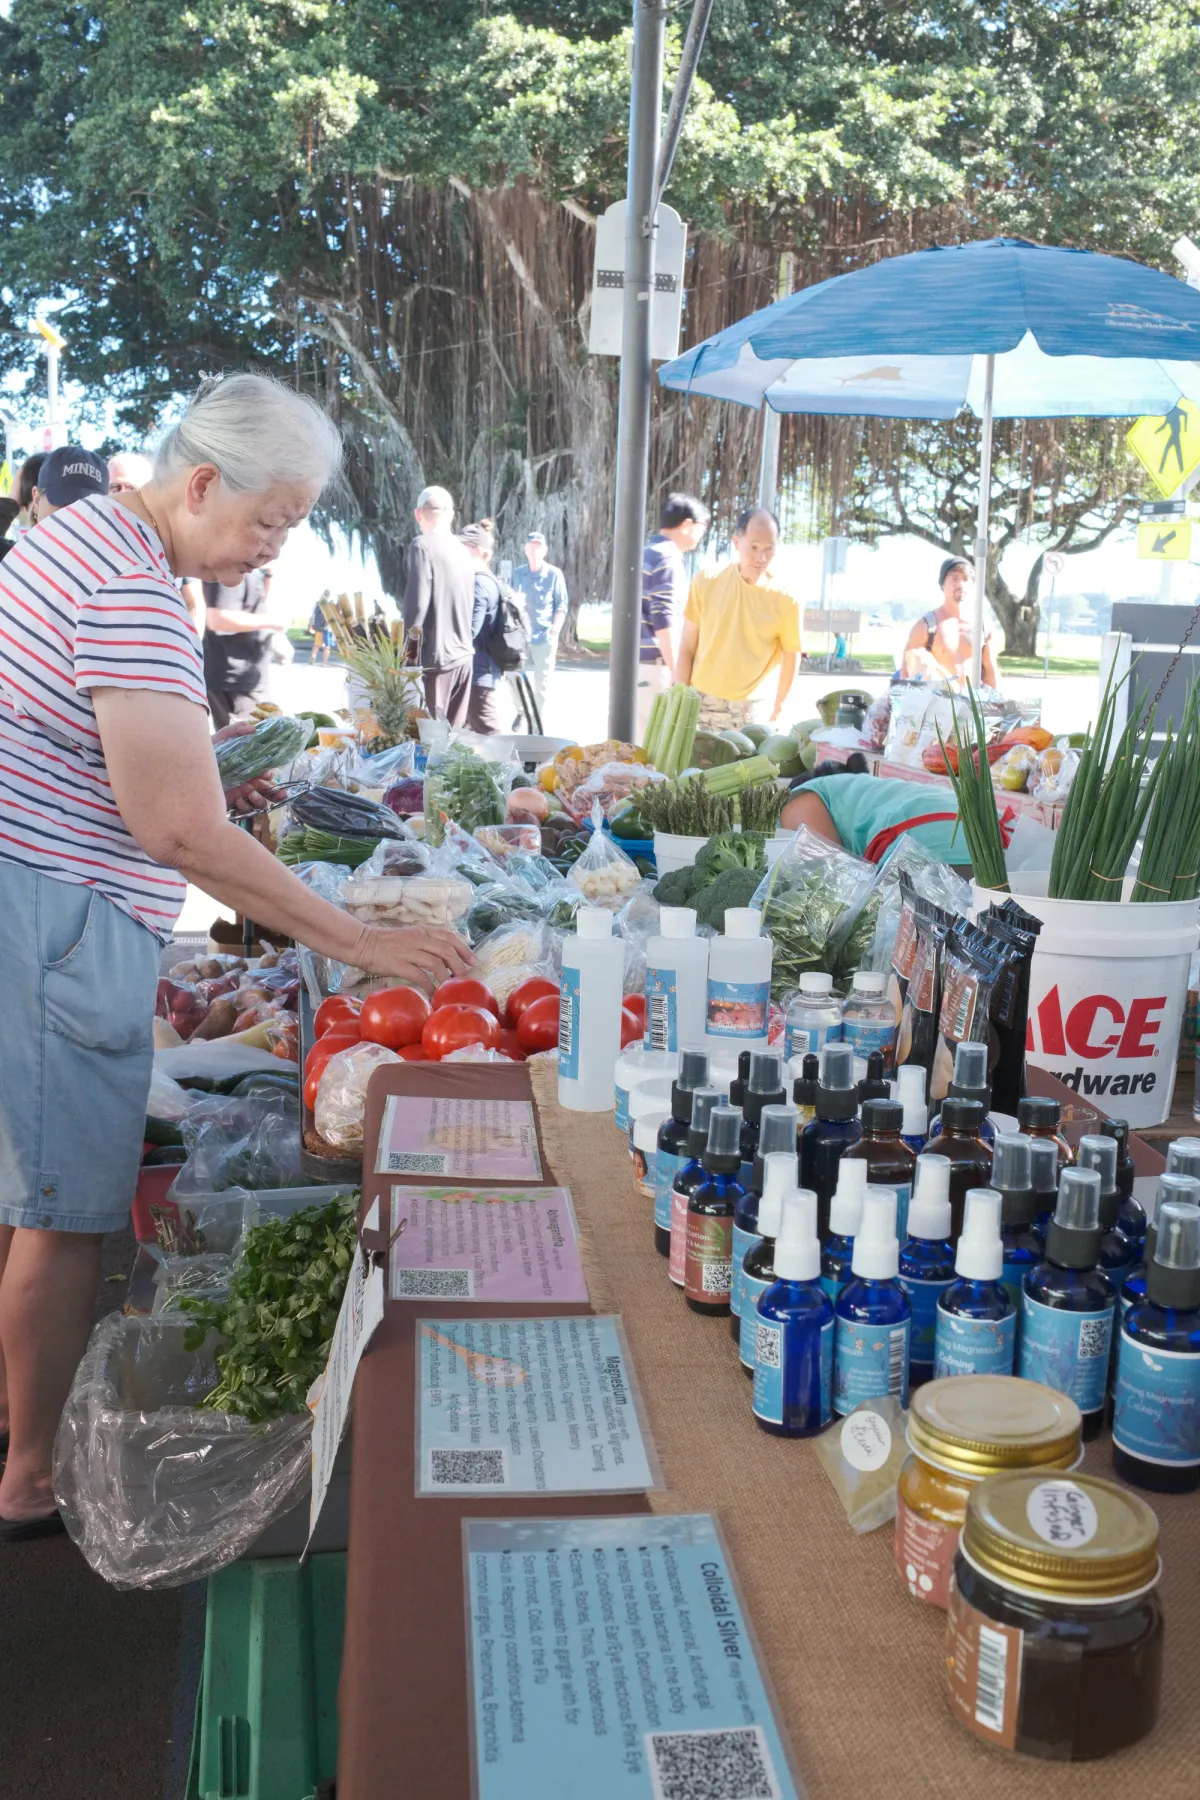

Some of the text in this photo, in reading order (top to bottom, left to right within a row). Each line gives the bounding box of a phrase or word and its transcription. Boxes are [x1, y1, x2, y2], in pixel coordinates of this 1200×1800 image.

[61, 462, 103, 484] MINES
[1026, 984, 1168, 1060] ACE
[1049, 1067, 1157, 1096] rdware
[539, 1367, 553, 1389] Flashes
[601, 1355, 630, 1405] Magnesium
[505, 1393, 519, 1419] Pressure
[540, 1390, 557, 1422] symptoms
[554, 1347, 567, 1362] Brain
[565, 1423, 582, 1450] Memory
[470, 1426, 482, 1444] Make
[505, 1420, 523, 1455] Regulation
[528, 1426, 542, 1449] Lowers
[531, 1450, 547, 1489] Cholesterol
[475, 1554, 489, 1593] common
[522, 1554, 538, 1574] Sore
[545, 1554, 562, 1578] Great
[566, 1553, 587, 1589] Eczema,
[592, 1552, 609, 1570] Skin
[613, 1559, 634, 1583] helps
[521, 1576, 541, 1606] throat,
[548, 1579, 569, 1633] Mouthwash
[698, 1562, 734, 1617] Colloidal
[497, 1585, 519, 1639] Respiratory
[572, 1590, 593, 1625] Rashes,
[620, 1601, 644, 1625] body
[629, 1628, 649, 1649] with
[673, 1609, 701, 1653] Antiviral,
[715, 1620, 747, 1660] Silver
[552, 1648, 575, 1679] gargle
[651, 1612, 675, 1652] bacteria
[663, 1686, 690, 1714] body
[560, 1681, 579, 1705] with
[634, 1651, 665, 1727] Detoxification
[481, 1702, 503, 1764] Bronchitis
